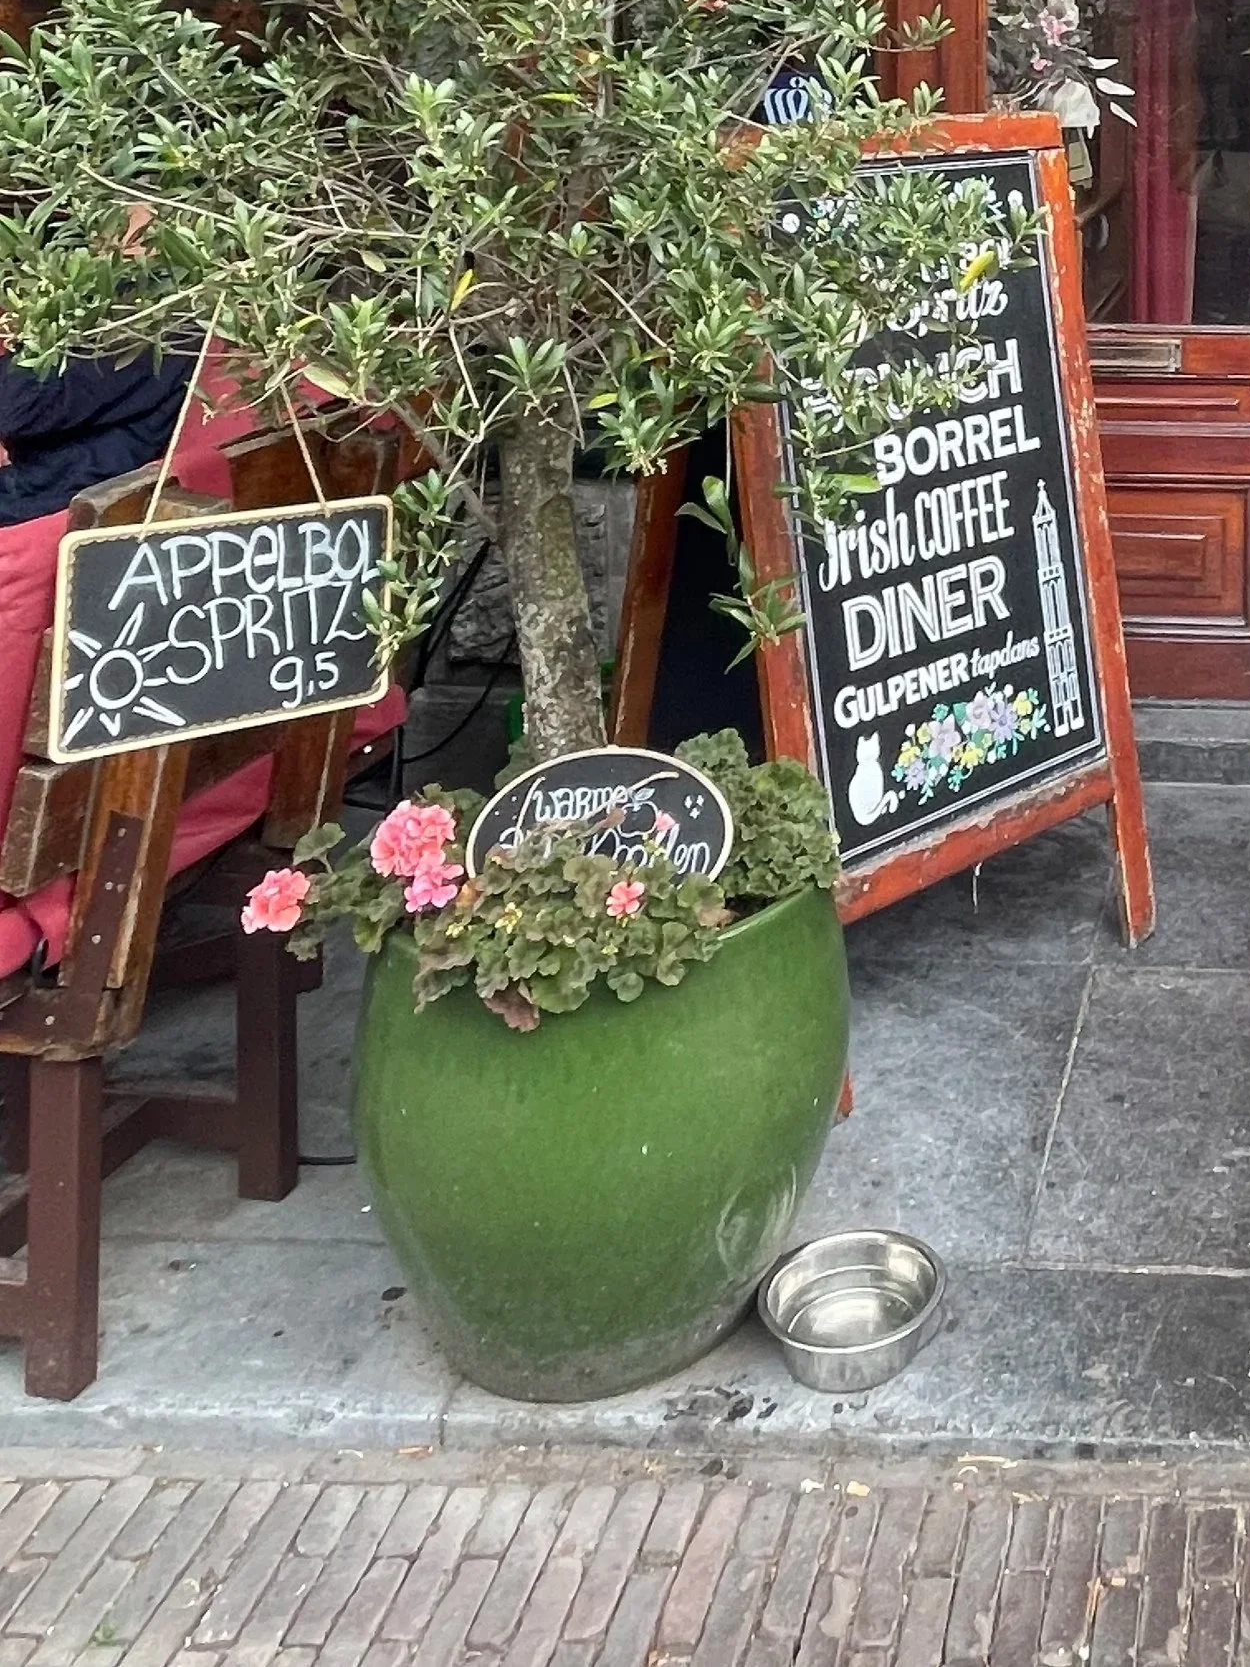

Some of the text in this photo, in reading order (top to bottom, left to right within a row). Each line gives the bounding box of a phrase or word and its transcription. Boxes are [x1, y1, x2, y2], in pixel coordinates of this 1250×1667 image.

[874, 404, 1041, 486] BORREL
[819, 470, 1015, 592] Irish COFFEE
[165, 581, 368, 685] SPRITZ
[841, 554, 1012, 672] DINER
[269, 650, 340, 710] 9,5
[833, 631, 1041, 729] GULPENER tapdans
